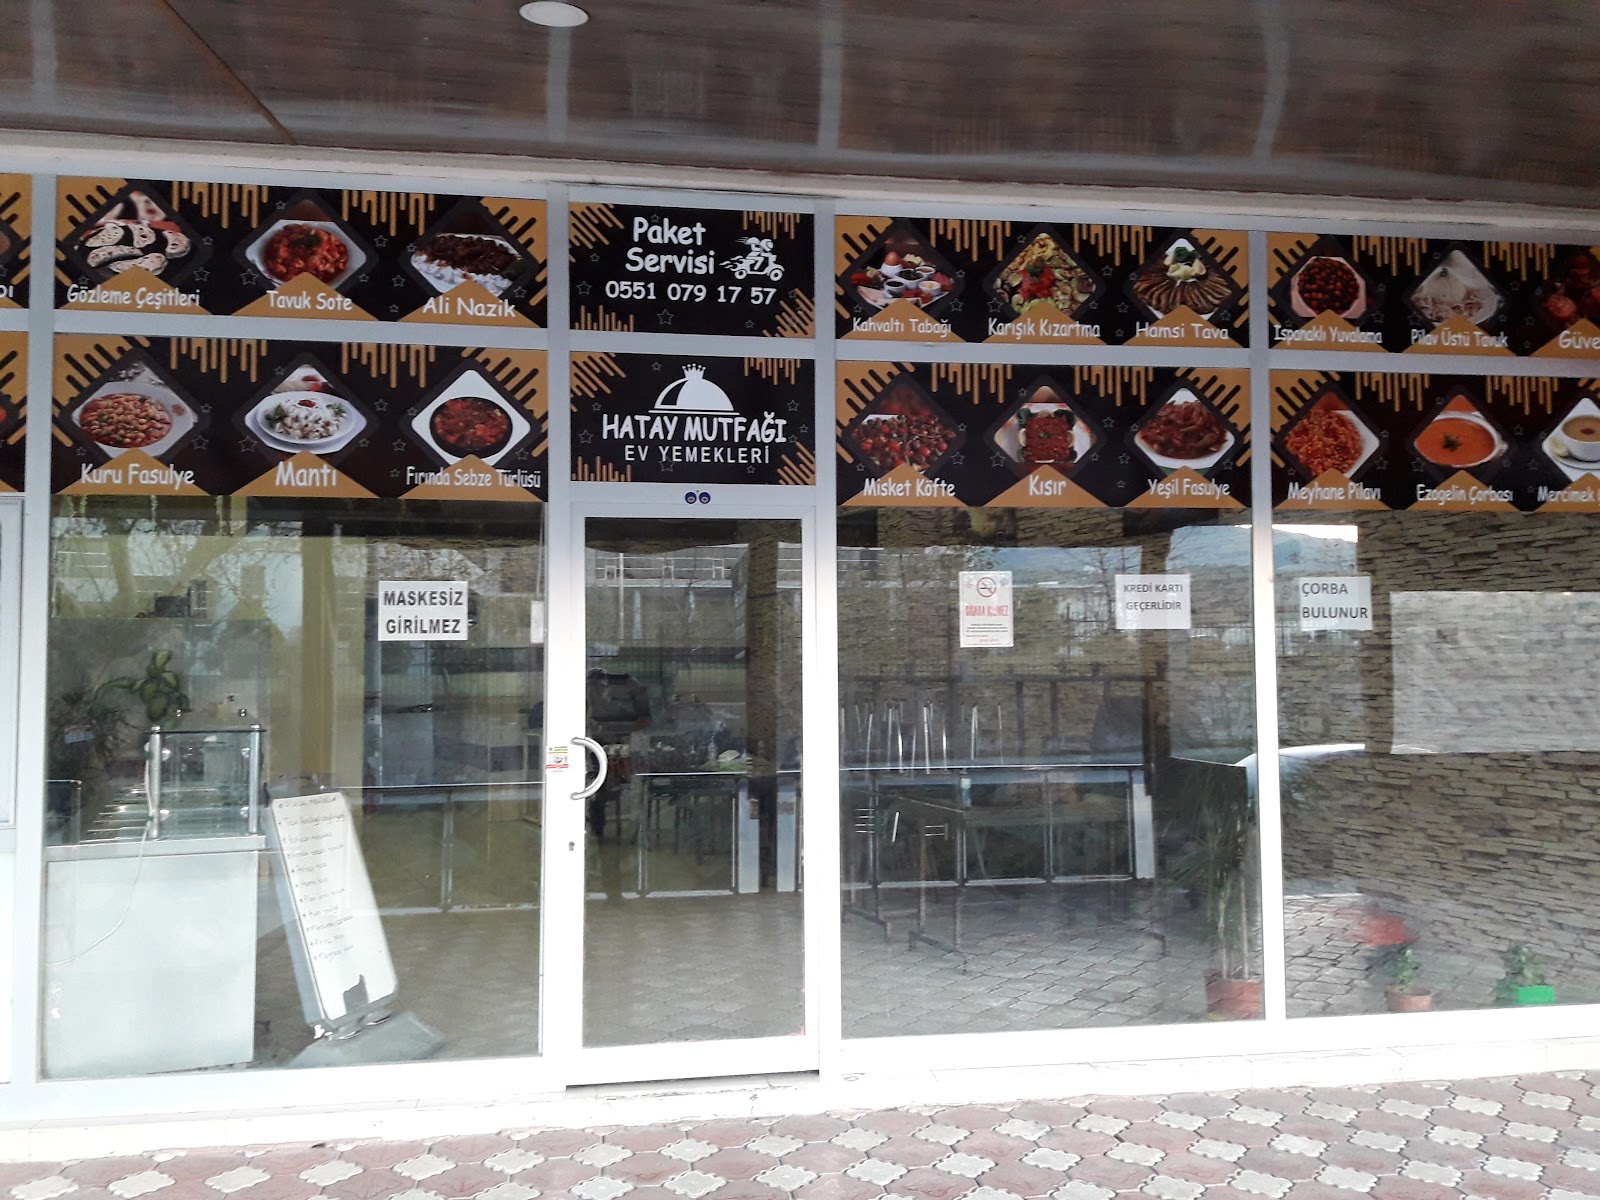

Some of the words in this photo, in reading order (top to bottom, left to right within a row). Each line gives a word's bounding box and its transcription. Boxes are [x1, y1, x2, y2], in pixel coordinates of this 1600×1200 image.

[633, 217, 706, 245] Paket
[625, 247, 715, 274] Servisi
[67, 284, 131, 304] Gözleme
[136, 289, 200, 309] Çeşitleri
[266, 290, 311, 310] Tavuk
[316, 292, 353, 311] Sote
[605, 280, 657, 300] 0551
[667, 283, 707, 301] 079
[717, 286, 742, 303] 17
[750, 287, 778, 305] 57
[423, 297, 450, 315] Ali
[457, 298, 516, 318] Nazik
[853, 317, 904, 333] Kahvaltı
[909, 318, 952, 338] Tabağı
[987, 317, 1036, 340] Karışık
[1039, 319, 1101, 337] Kızartma
[1135, 321, 1185, 338] Hamsi
[1191, 323, 1229, 340] Tava
[1274, 325, 1327, 345] Ispanaklı
[1328, 326, 1383, 343] Yuvalama
[1411, 328, 1438, 345] Pilav
[1441, 328, 1470, 346] Üstü
[1473, 331, 1508, 348] Tavuk
[602, 413, 678, 441] HATAY
[683, 410, 787, 443] MUTFAĞI
[624, 445, 649, 461] EV
[659, 445, 770, 464] YEMEKLERİ
[80, 463, 122, 484] Kuru
[128, 463, 196, 490] Fasulye
[275, 461, 336, 486] Mantı
[406, 466, 450, 485] Fırında
[454, 468, 492, 486] Sebze
[496, 469, 541, 488] Türlüsü
[863, 477, 911, 496] Misket
[915, 477, 956, 497] Köfte
[1029, 474, 1067, 496] Kısır
[1147, 478, 1179, 499] Yeşil
[1184, 478, 1231, 500] Fasulye
[1287, 481, 1346, 505] Meyhane
[1348, 481, 1382, 500] Pilavı
[1416, 483, 1467, 506] Ezogelin
[1469, 485, 1514, 505] Çorbası
[383, 588, 464, 606] MASKESİZ
[1123, 582, 1153, 593] KREDİ
[1155, 584, 1183, 593] KARTI
[1301, 582, 1348, 598] ÇORBA
[1302, 606, 1369, 619] BULUNUR
[386, 615, 461, 634] GİRİLMEZ
